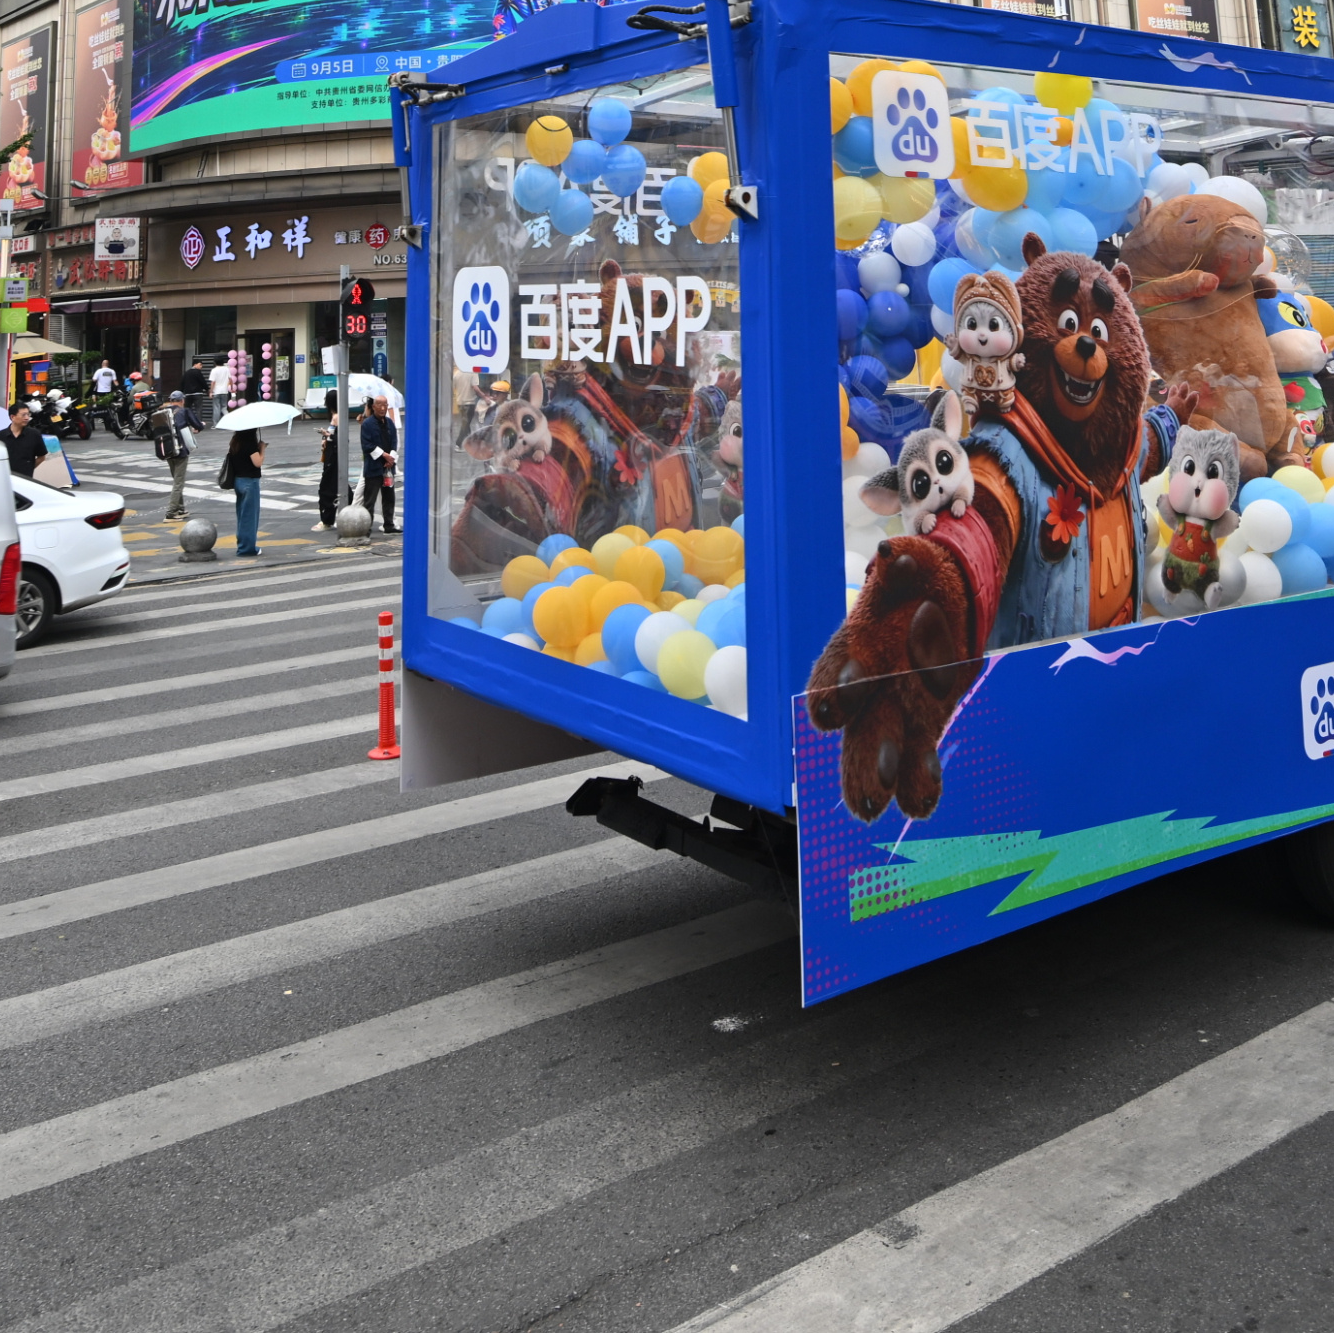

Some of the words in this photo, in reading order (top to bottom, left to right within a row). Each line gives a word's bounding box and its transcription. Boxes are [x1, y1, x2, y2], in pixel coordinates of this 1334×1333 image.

[311, 59, 354, 75] 9月5日
[898, 128, 931, 157] du
[961, 98, 1163, 178] 百度APP
[212, 216, 312, 262] 正和祥
[373, 253, 408, 265] NO.63
[345, 314, 368, 335] 30
[519, 275, 712, 368] 百度APP
[468, 322, 492, 351] du
